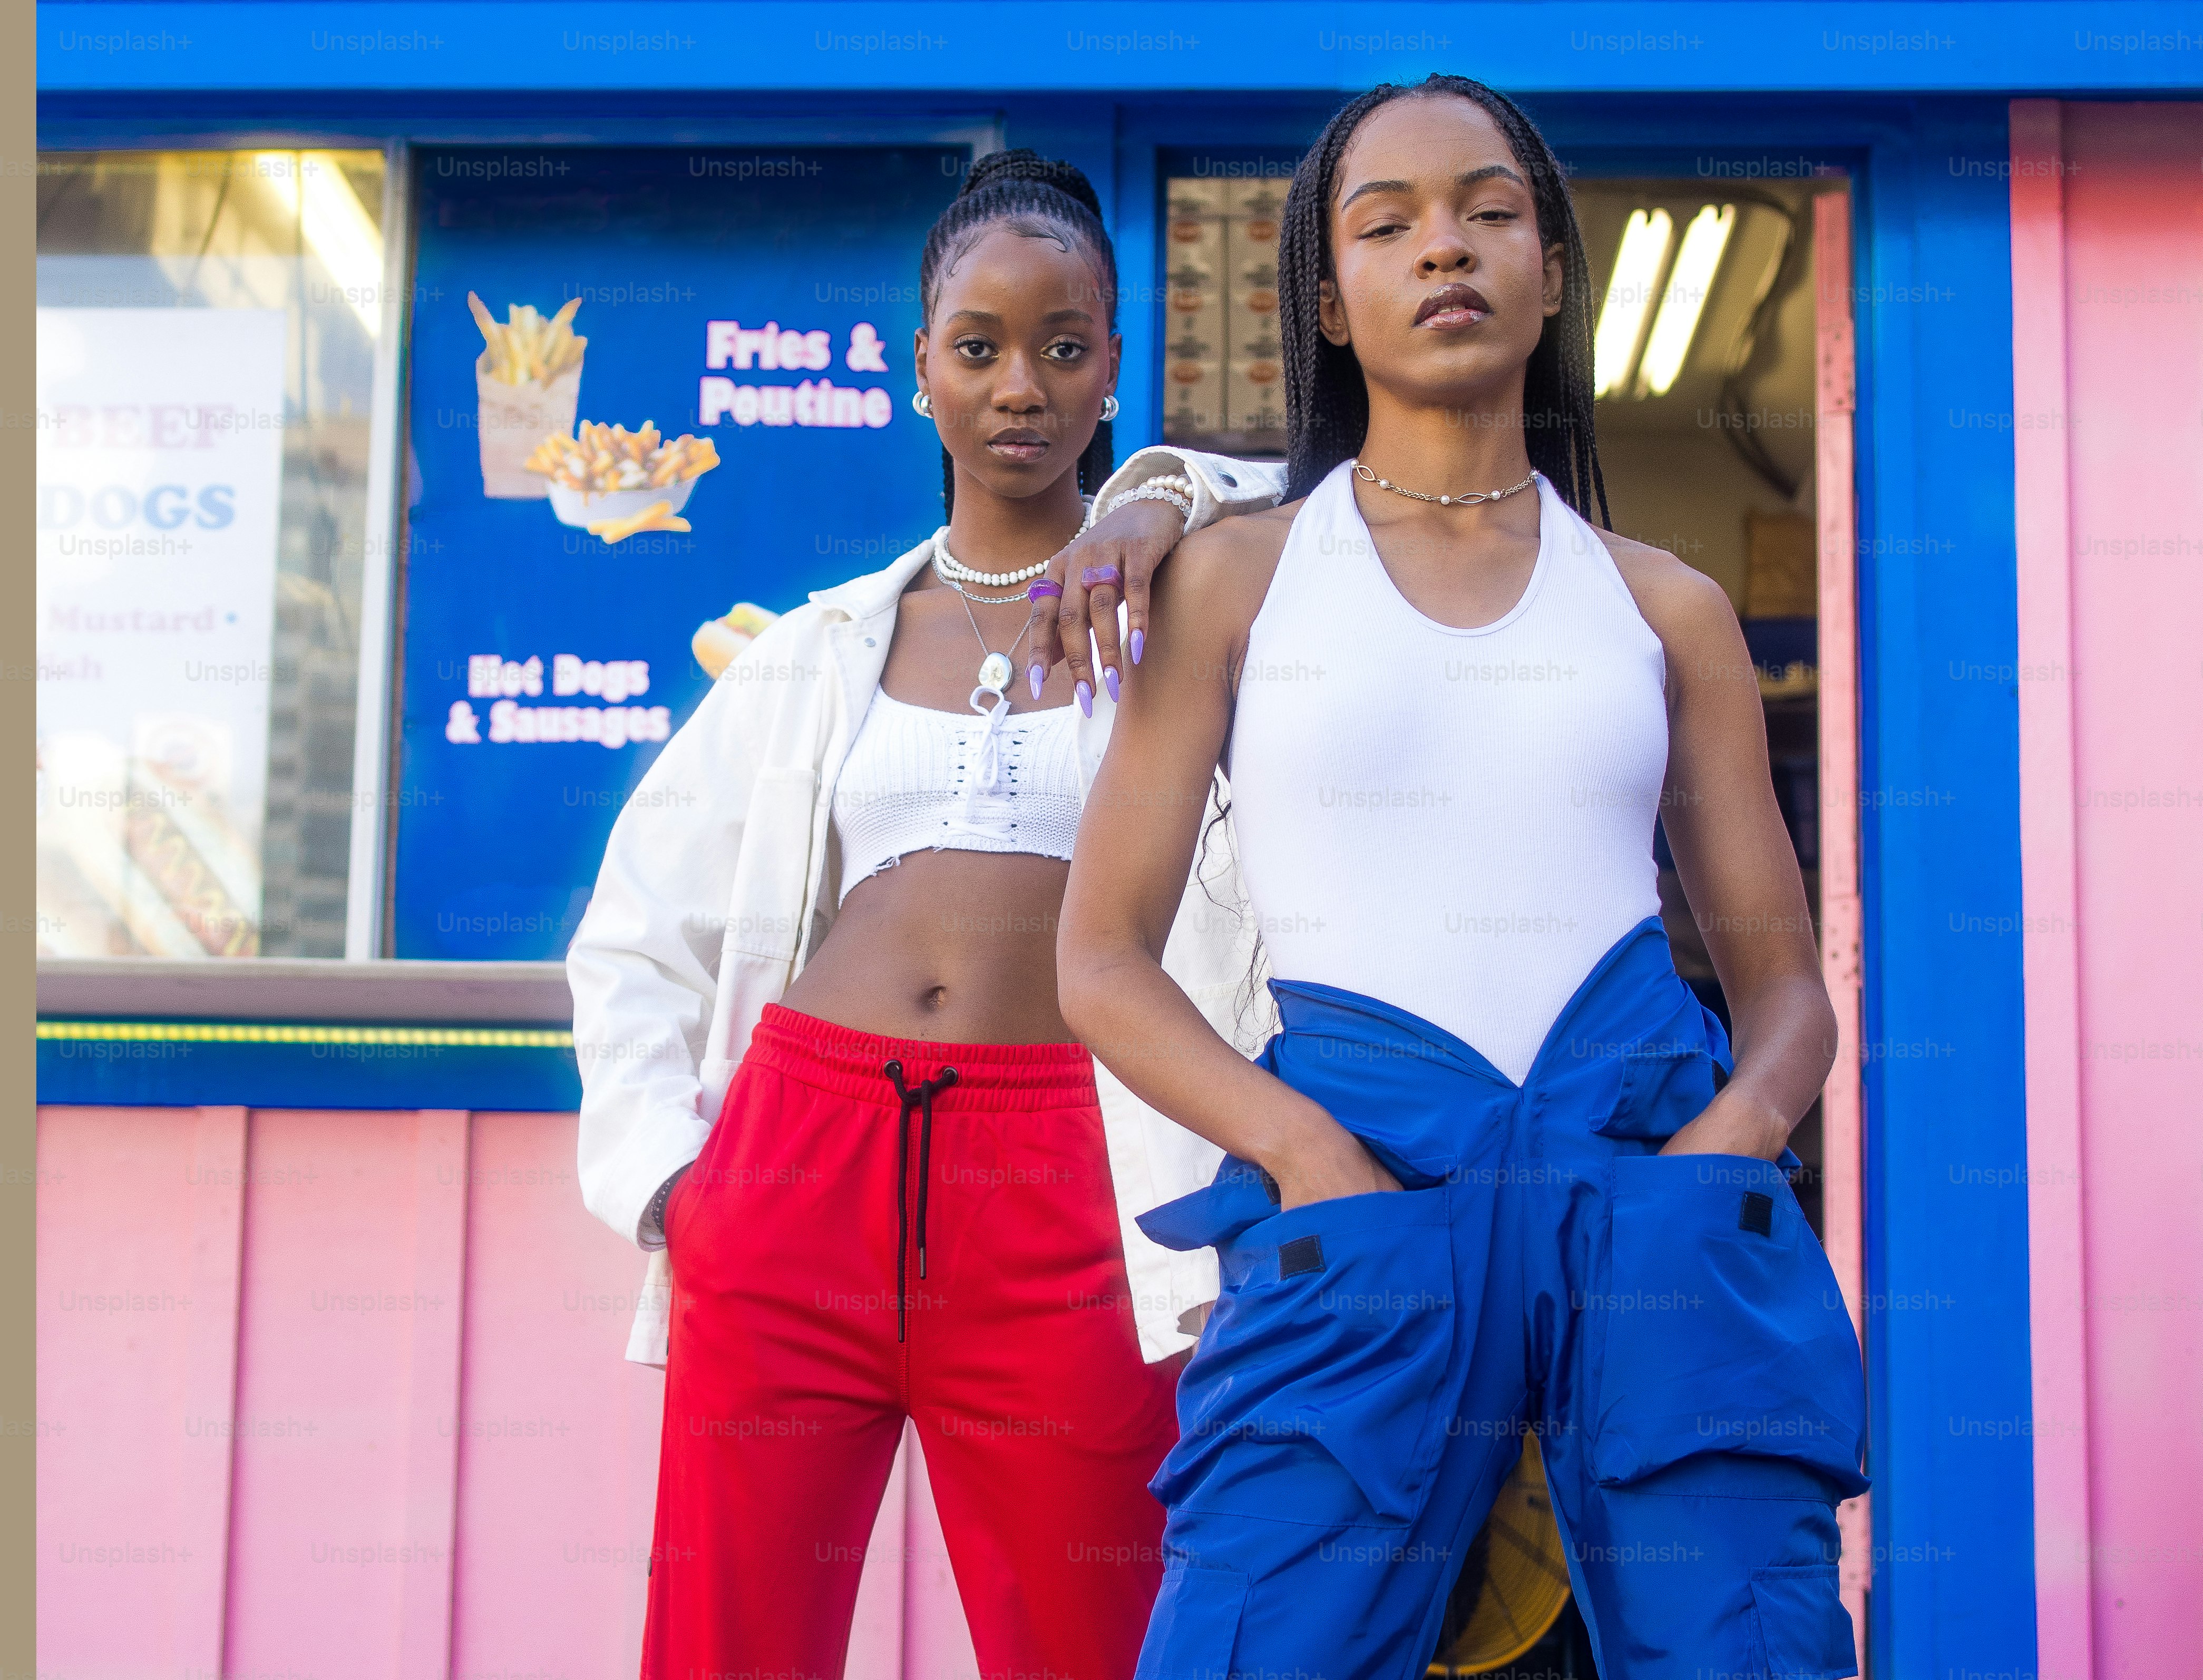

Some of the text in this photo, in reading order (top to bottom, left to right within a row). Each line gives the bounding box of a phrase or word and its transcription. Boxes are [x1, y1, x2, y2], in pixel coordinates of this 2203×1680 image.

[706, 320, 890, 373] Fries &
[52, 403, 235, 450] BEEF
[699, 375, 893, 429] Poutine
[38, 483, 236, 530] DOGS
[48, 604, 215, 633] Mustard
[468, 653, 650, 704] Hot Dogs
[445, 699, 670, 749] & Sausages
